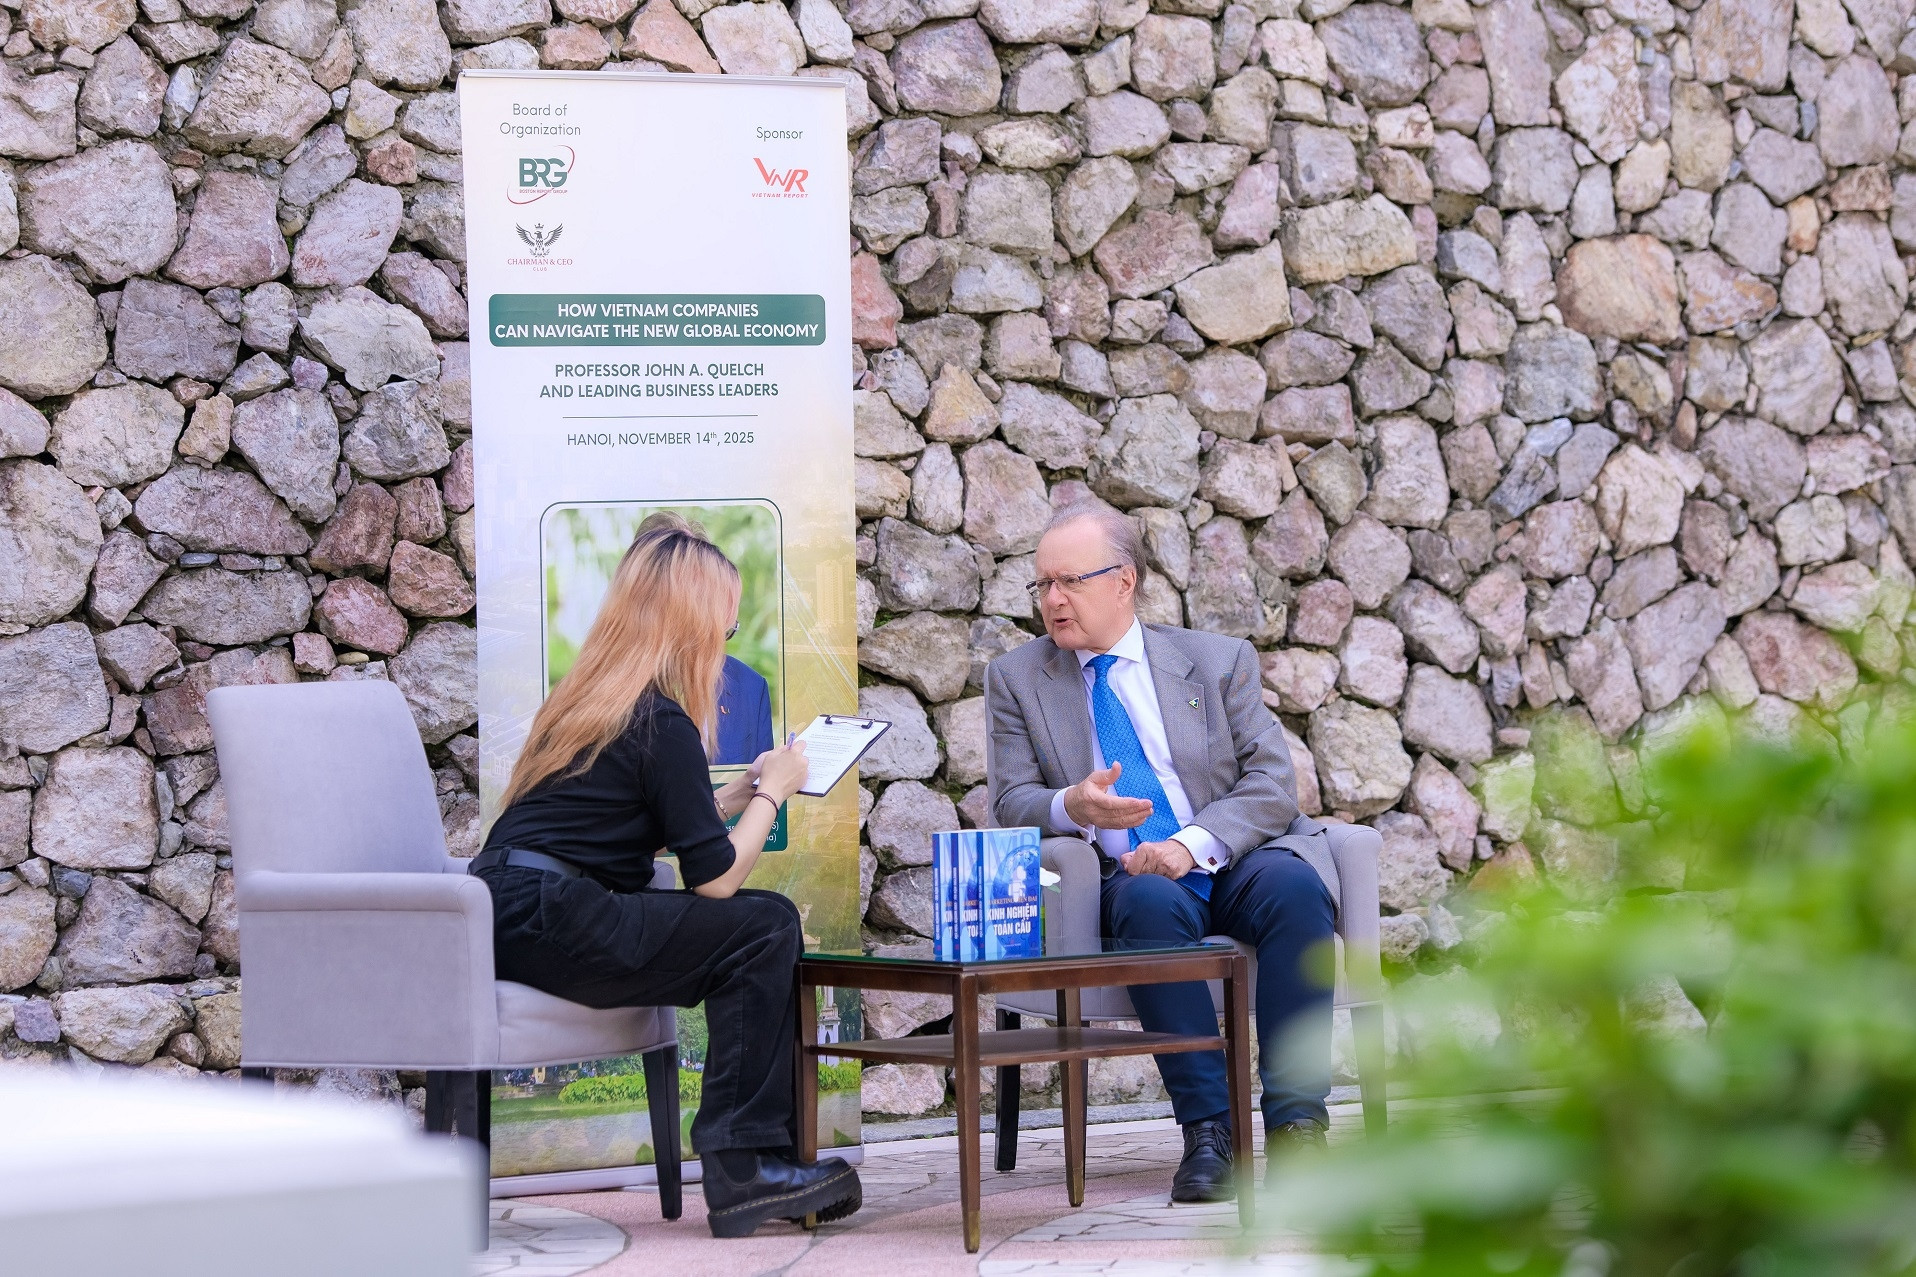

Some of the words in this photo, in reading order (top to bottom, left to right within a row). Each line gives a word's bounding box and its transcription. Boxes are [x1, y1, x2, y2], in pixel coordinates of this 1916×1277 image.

[512, 103, 551, 116] Board
[554, 103, 568, 116] of
[499, 121, 581, 139] Organization
[756, 126, 804, 142] Sponsor
[518, 157, 568, 188] BRG
[507, 258, 549, 266] CHAIRMAN
[549, 258, 556, 266] &
[556, 258, 573, 266] CEO
[557, 303, 598, 317] HOW
[600, 303, 669, 317] VIETNAM
[672, 303, 759, 317] COMPANIES
[494, 324, 529, 338] CAN
[532, 324, 610, 338] NAVIGATE
[612, 324, 640, 338] THE
[643, 323, 680, 338] NEW
[682, 323, 741, 338] GLOBAL
[743, 323, 819, 338] ECONOMY
[555, 363, 641, 377] PROFESSOR
[644, 363, 685, 377] JOHN
[688, 363, 704, 377] A.
[707, 363, 764, 380] QUELCH
[539, 384, 574, 398] AND
[578, 384, 642, 398] LEADING
[645, 383, 715, 397] BUSINESS
[718, 383, 779, 397] LEADERS
[567, 433, 615, 448] HANOI,
[618, 432, 691, 445] NOVEMBER
[723, 431, 755, 444] 2025
[944, 910, 953, 923] KIN
[962, 908, 978, 923] KINH
[987, 907, 1005, 921] KINH
[1006, 902, 1038, 920] NGHIỆM
